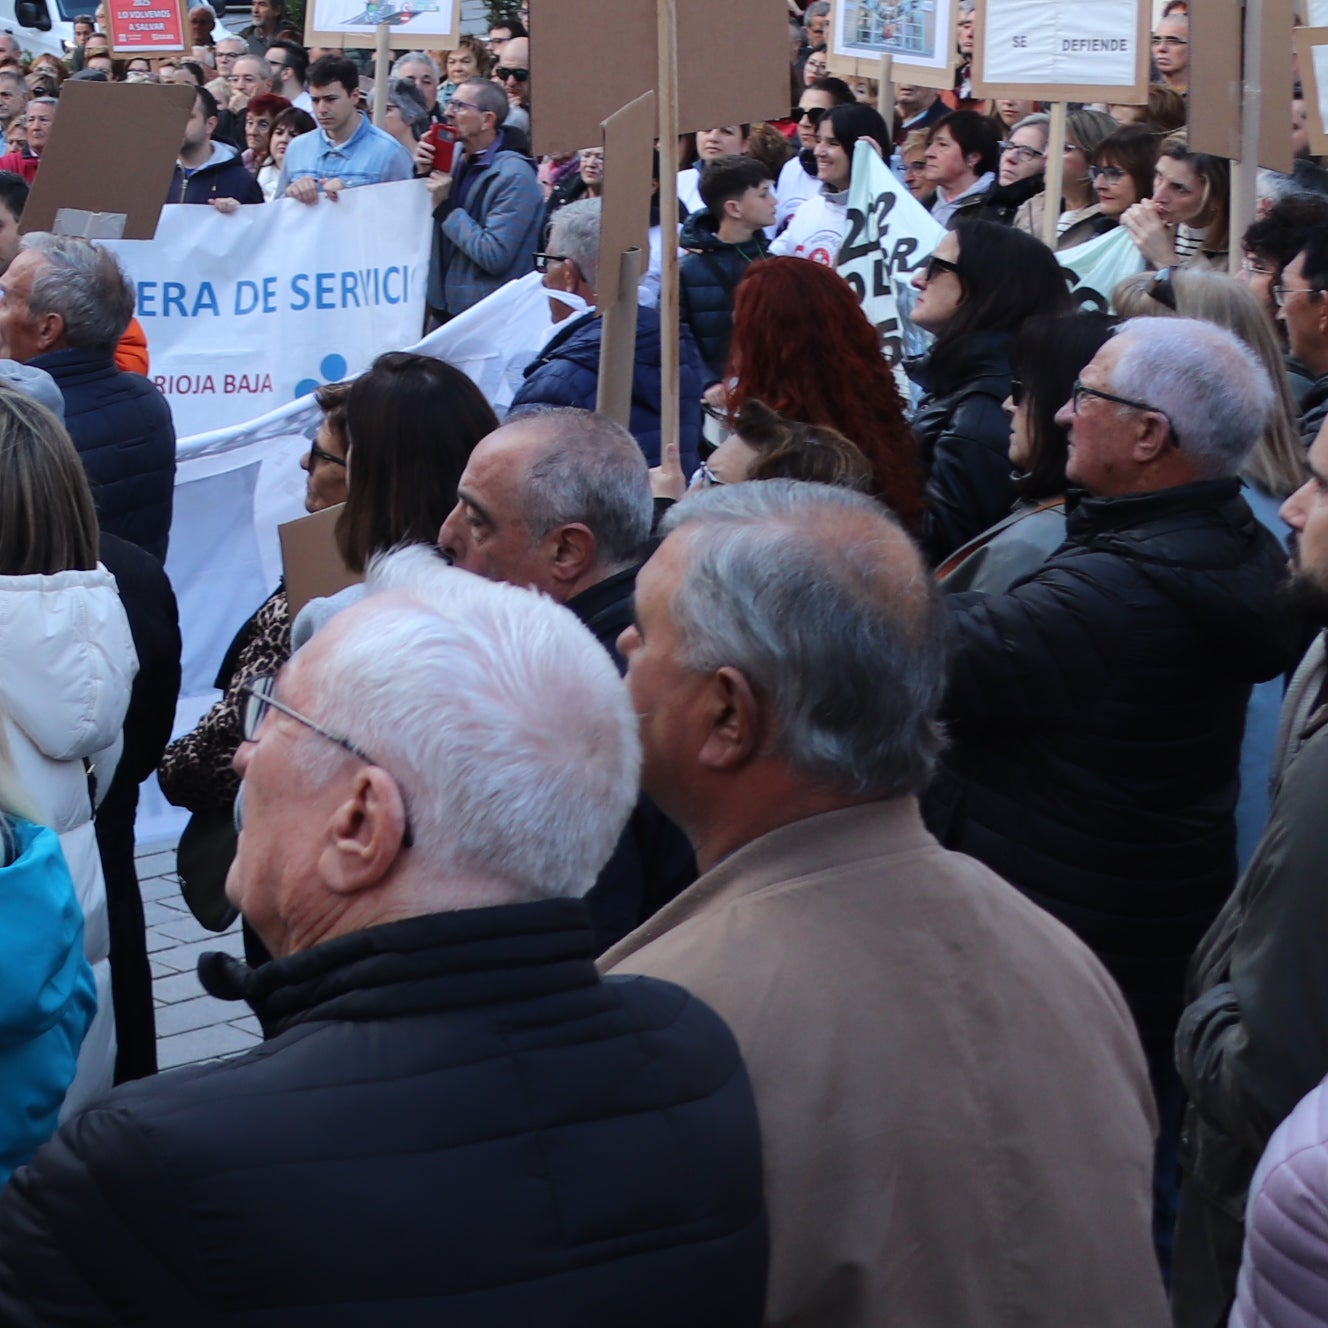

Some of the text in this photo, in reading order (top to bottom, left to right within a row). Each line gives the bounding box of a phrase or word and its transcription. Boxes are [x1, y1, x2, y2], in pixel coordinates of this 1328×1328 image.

[117, 10, 171, 19] LO VOLVEMOS
[129, 22, 165, 31] A SALVAR
[1012, 36, 1028, 48] SE
[1062, 39, 1128, 52] DEFIENDE
[137, 281, 220, 318] ERA
[234, 276, 278, 316] DE
[154, 373, 273, 395] RIOJA BAJA
